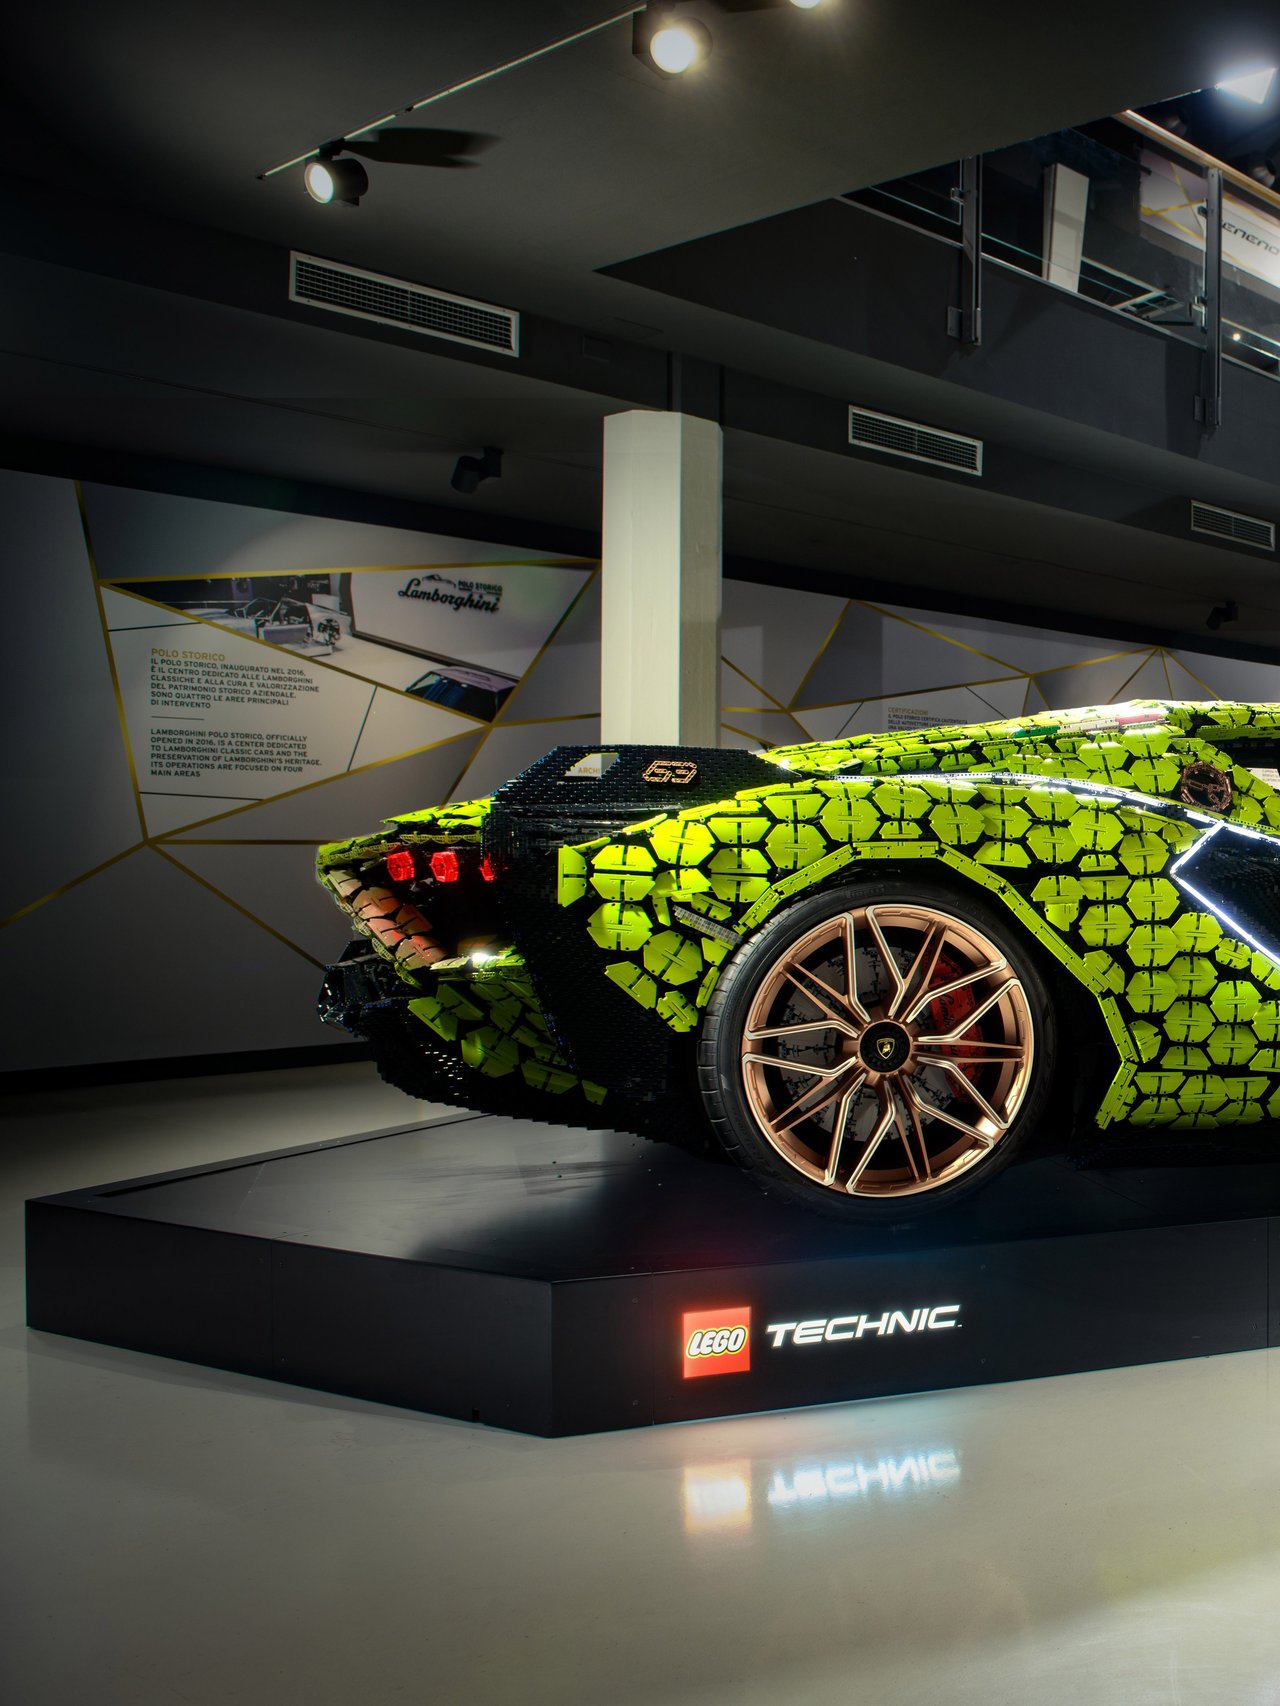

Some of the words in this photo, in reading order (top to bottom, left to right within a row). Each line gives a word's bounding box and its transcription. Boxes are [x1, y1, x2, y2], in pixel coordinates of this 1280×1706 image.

[1222, 222, 1280, 255] ENENO
[398, 578, 500, 612] Lamborghini
[151, 649, 179, 658] POLO
[182, 651, 225, 661] STORICO
[160, 659, 181, 667] POLO
[221, 664, 268, 673] INAUGURATO
[168, 667, 199, 676] CENTRO
[202, 669, 239, 678] DEDICATO
[241, 672, 260, 680] ALLE
[262, 674, 313, 684] LAMBORGHINI
[151, 675, 194, 684] CLASSICHE
[257, 682, 320, 692] VALORIZZAZIONE
[168, 684, 216, 693] PATRIMONIO
[151, 691, 173, 699] SONO
[175, 693, 211, 701] QUATTRO
[248, 697, 289, 706] PRINCIPALI
[161, 700, 211, 709] INTERVENTO
[151, 729, 206, 737] LAMBORGHINI
[163, 746, 218, 754] LAMBORGHINI
[266, 742, 306, 750] DEDICATED
[151, 754, 209, 762] PRESERVATION
[166, 762, 215, 770] OPERATIONS
[642, 760, 697, 783] 63
[766, 1304, 960, 1348] TECHNIC
[689, 1328, 745, 1356] LEGO
